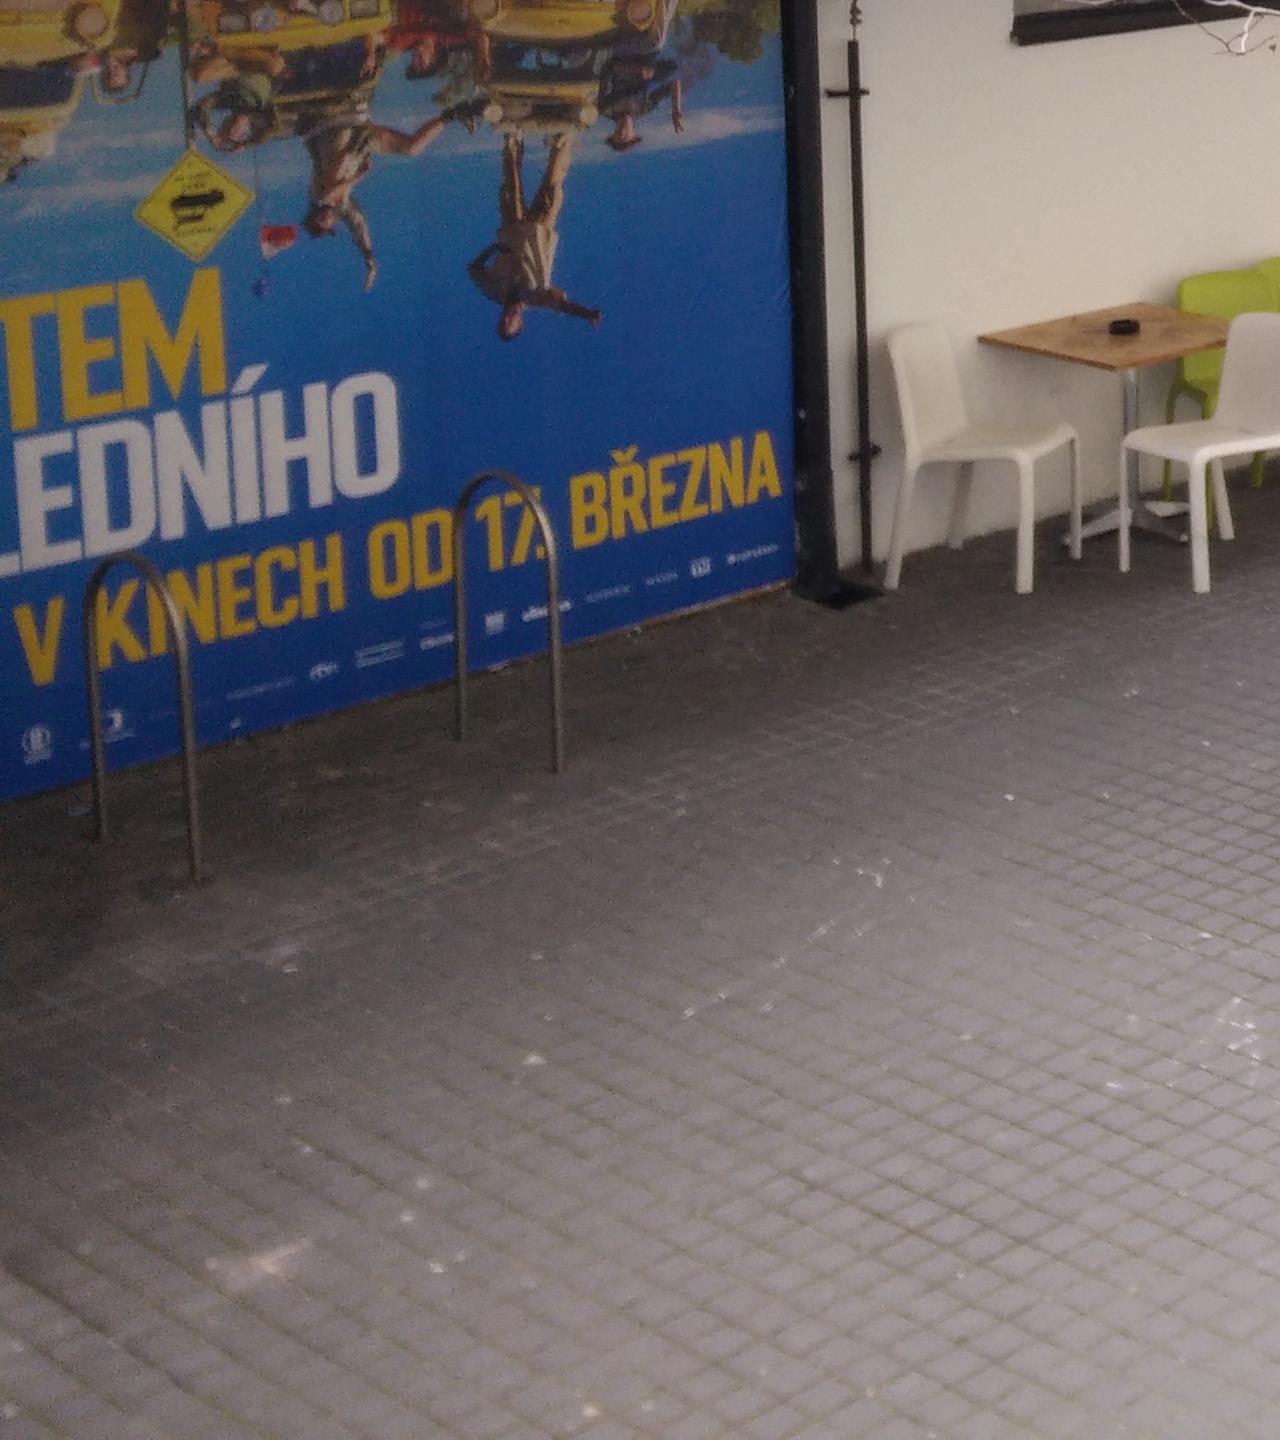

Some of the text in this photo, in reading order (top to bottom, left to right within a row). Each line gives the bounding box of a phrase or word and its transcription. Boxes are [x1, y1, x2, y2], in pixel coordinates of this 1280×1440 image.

[0, 266, 228, 432] TEM
[14, 596, 64, 687] V
[95, 533, 347, 672] KINECH
[367, 508, 456, 600] OD
[569, 430, 782, 551] BŘEZNA
